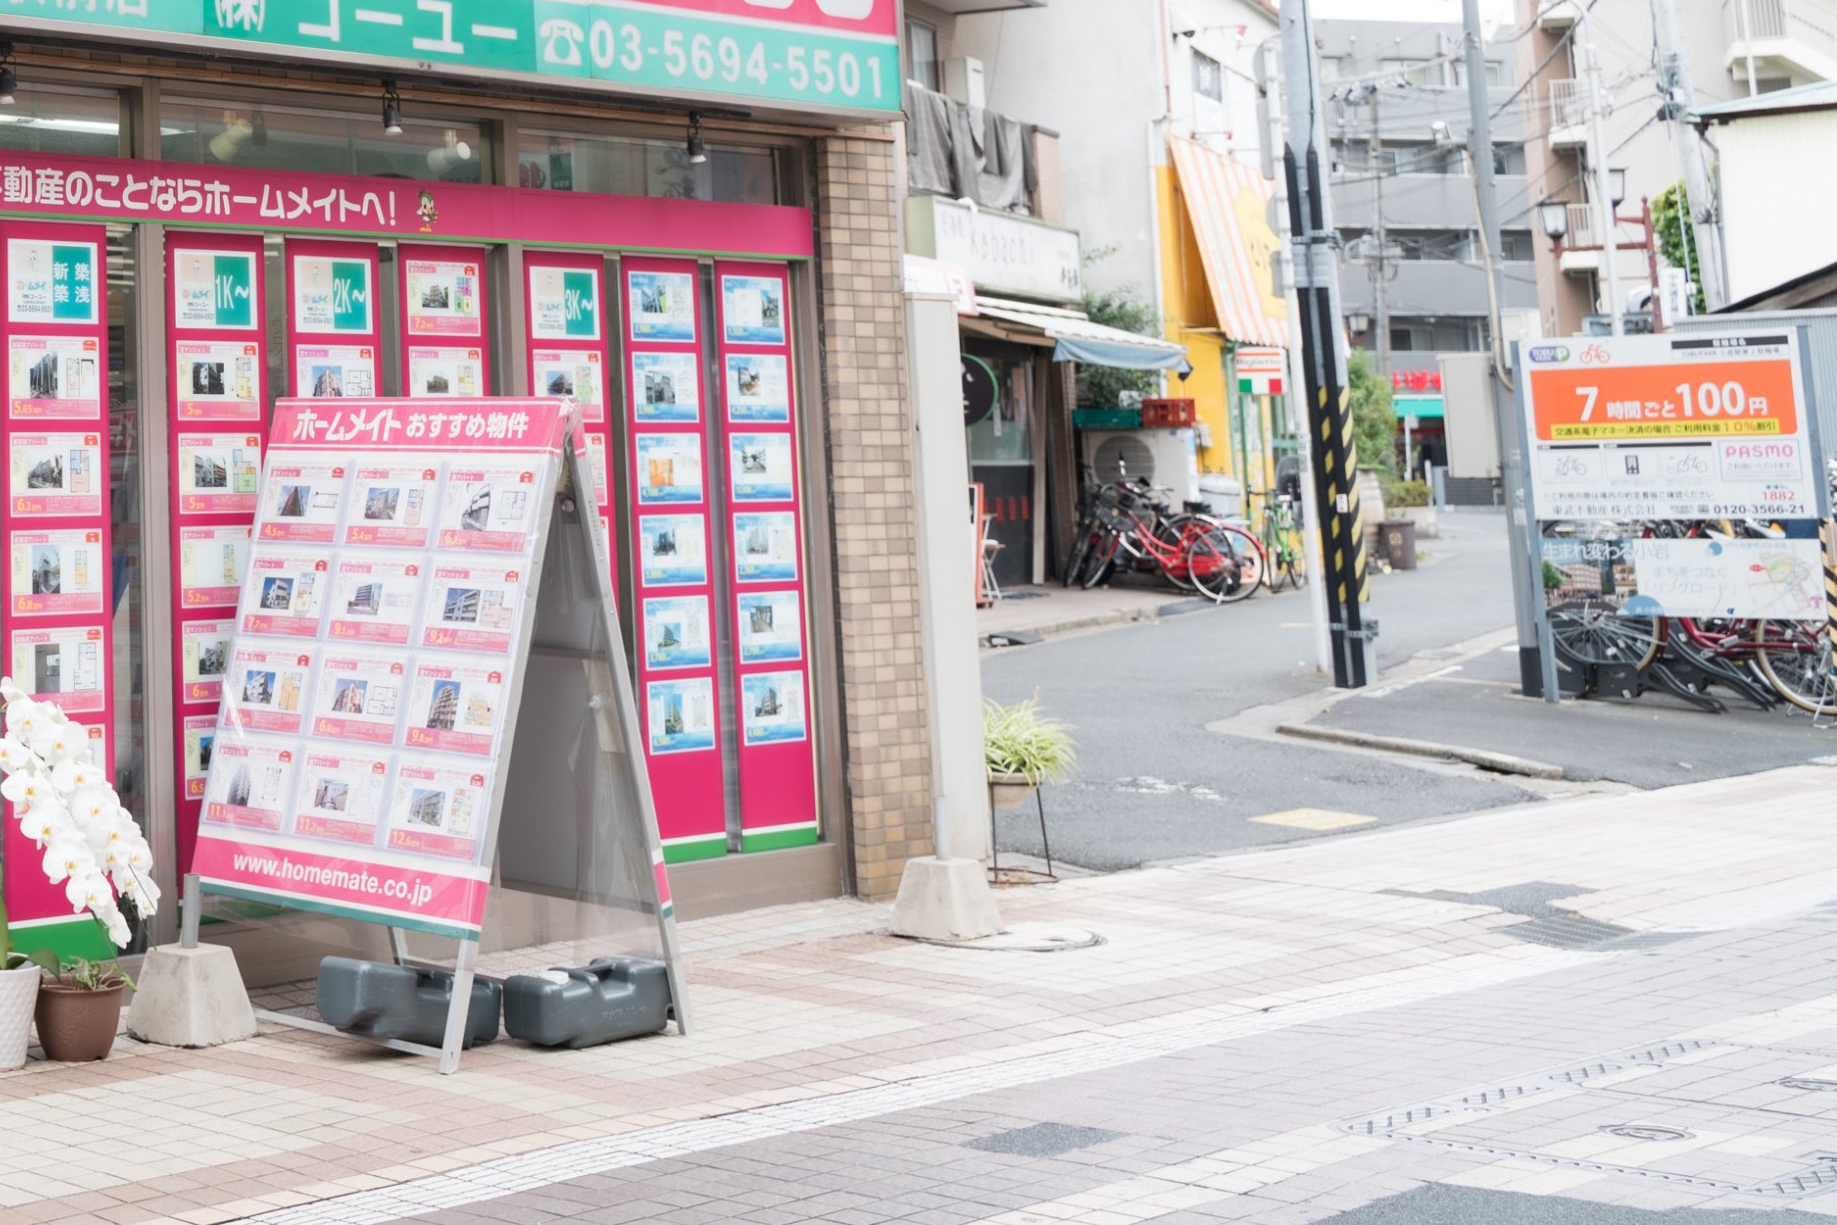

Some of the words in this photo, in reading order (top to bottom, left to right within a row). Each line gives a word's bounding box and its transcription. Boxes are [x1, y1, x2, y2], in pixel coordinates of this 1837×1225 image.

[589, 19, 883, 100] 03-5694-5501
[293, 409, 401, 442] ホームメイト
[407, 411, 529, 439] おすすめ物件
[1725, 444, 1794, 459] PASMO
[1762, 490, 1796, 502] 1882
[1713, 503, 1805, 515] 0120-3566-21
[233, 853, 433, 907] www.homemate.co.jp
